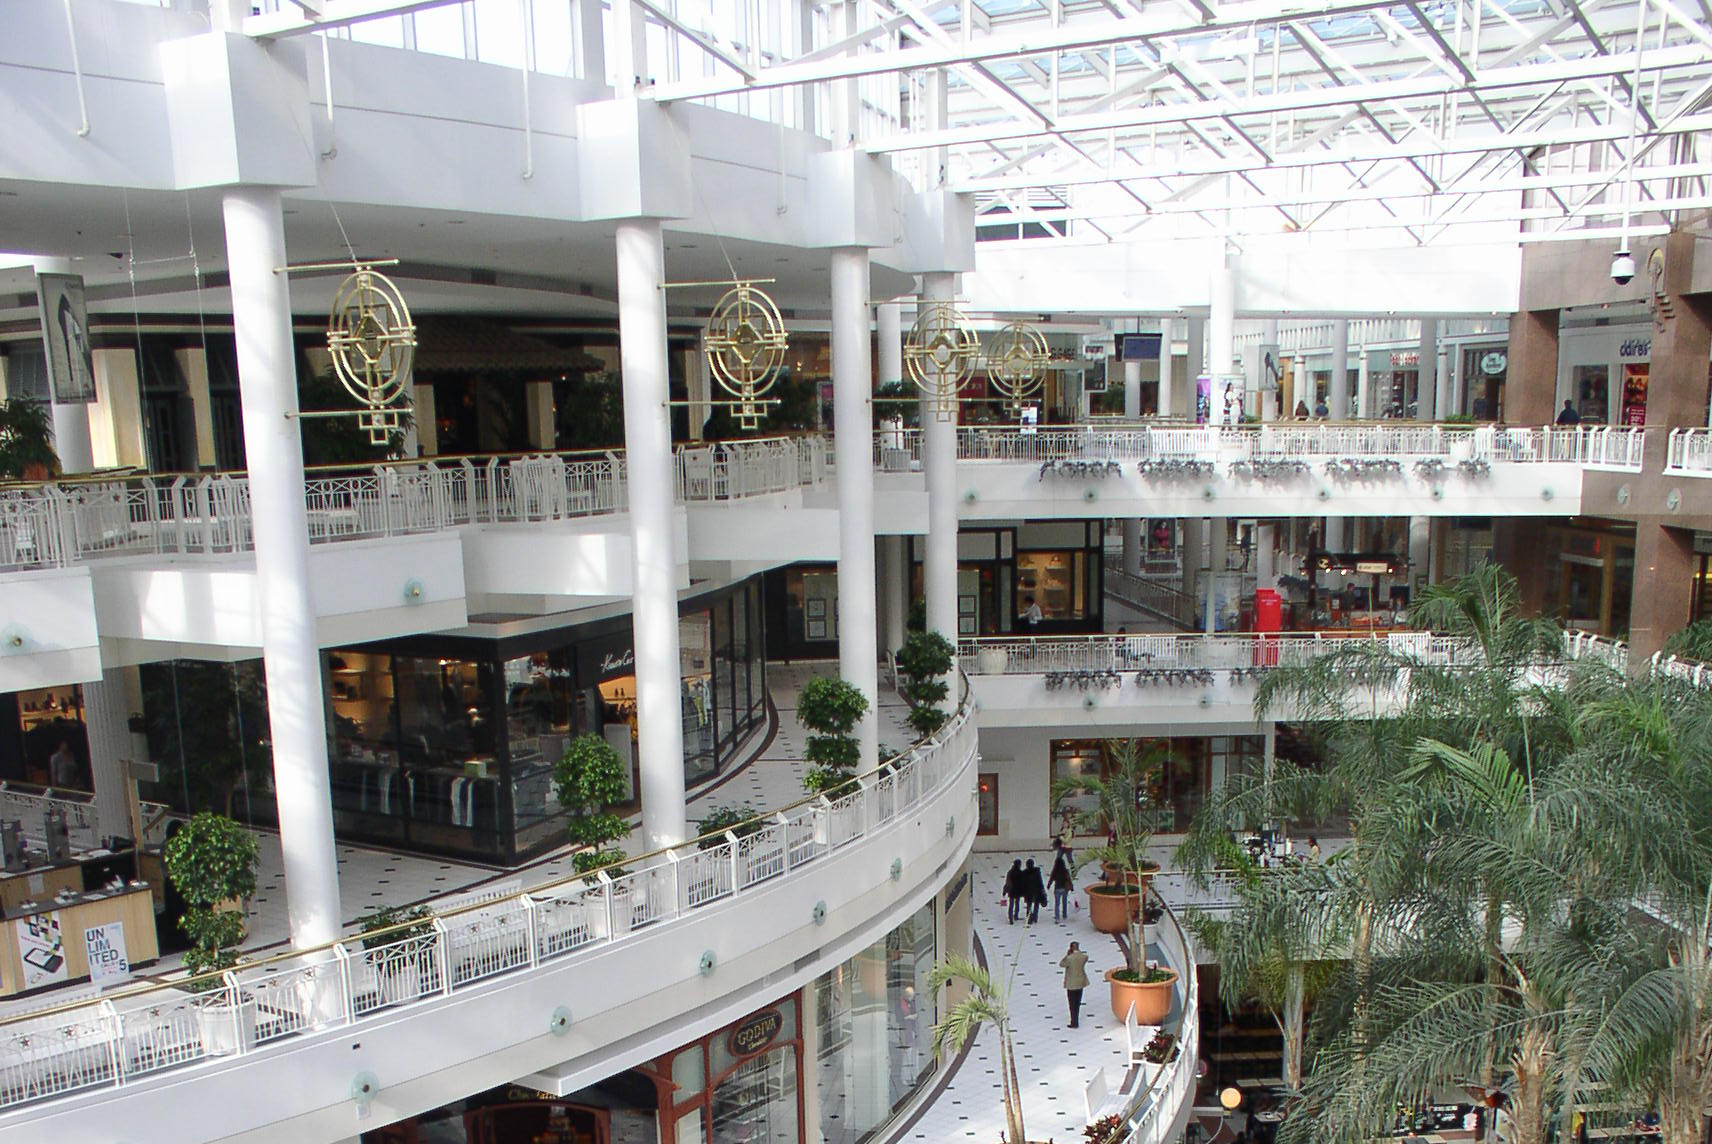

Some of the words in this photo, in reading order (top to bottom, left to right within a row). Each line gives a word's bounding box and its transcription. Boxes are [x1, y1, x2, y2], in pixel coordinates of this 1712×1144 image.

[86, 927, 105, 942] UN
[87, 939, 111, 954] LIM
[89, 949, 119, 966] ITED
[119, 958, 127, 971] 5
[738, 1017, 776, 1046] GODIVA
